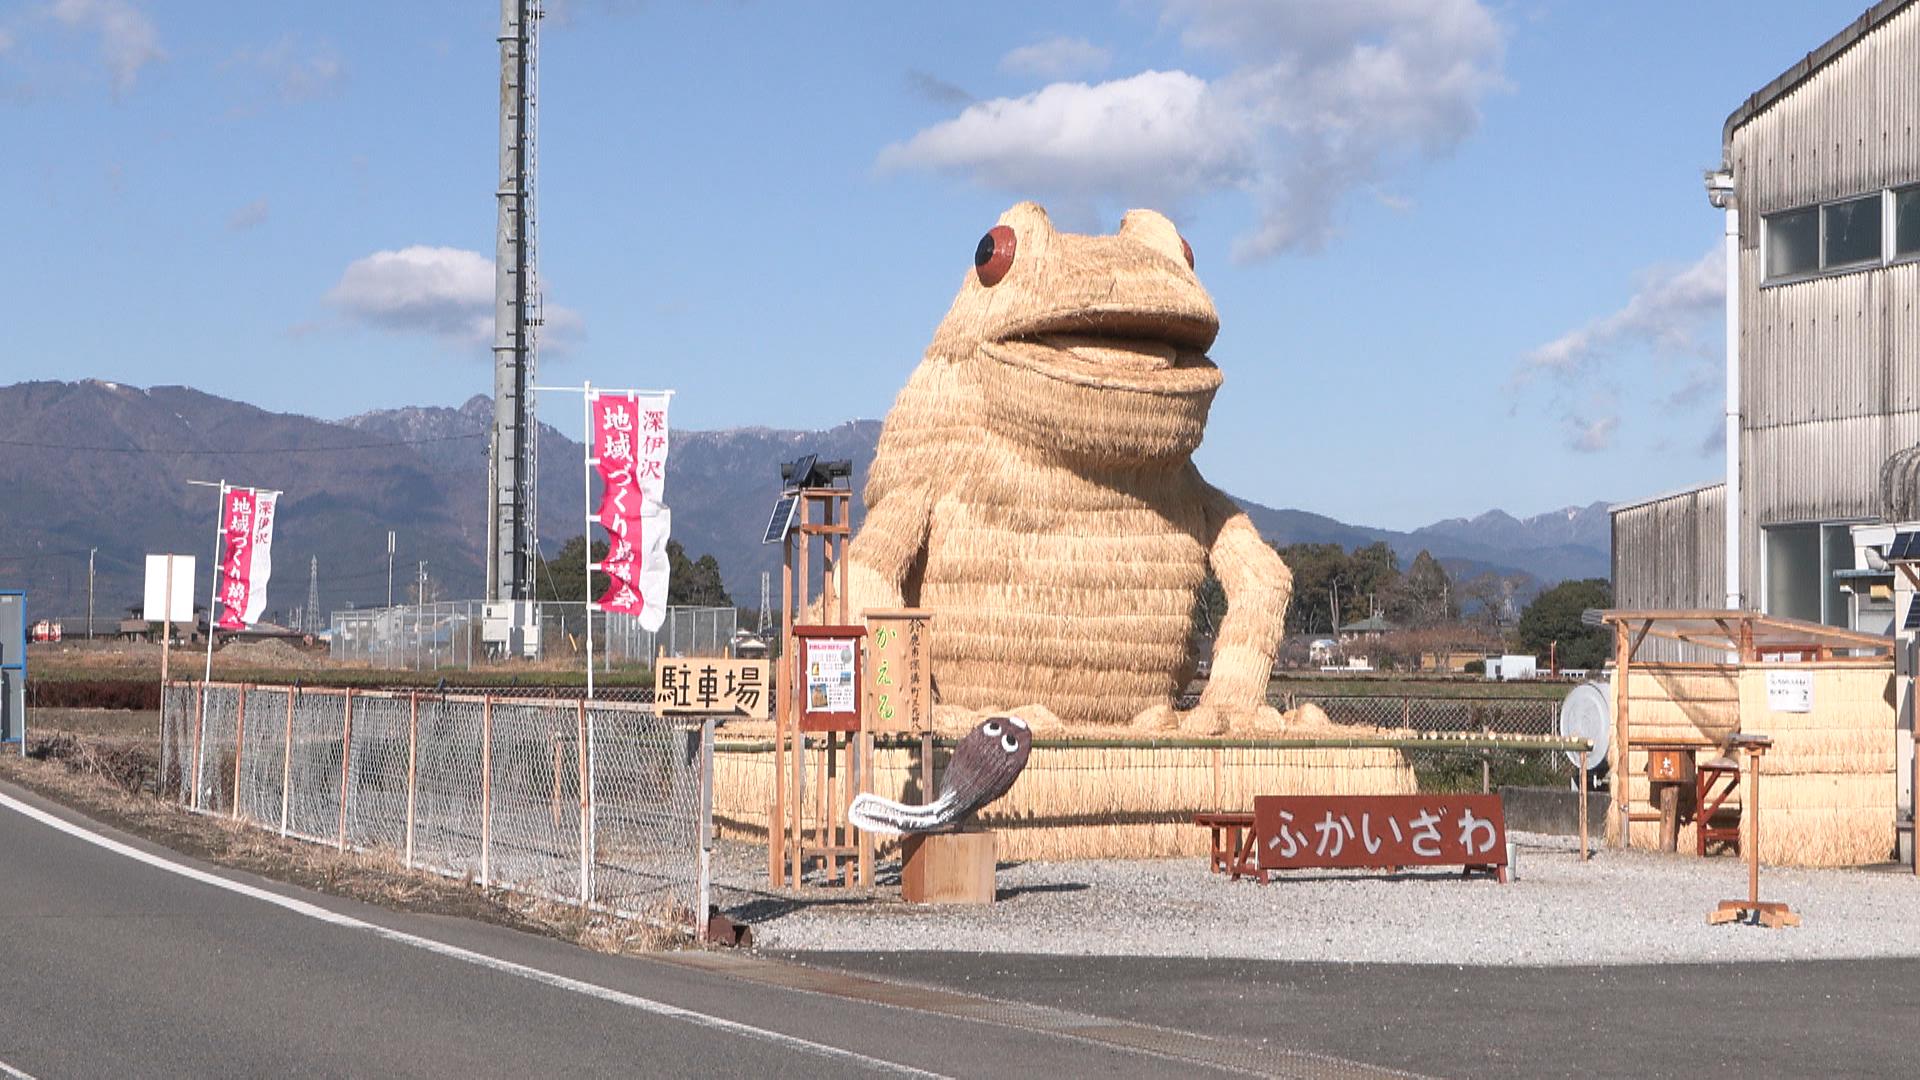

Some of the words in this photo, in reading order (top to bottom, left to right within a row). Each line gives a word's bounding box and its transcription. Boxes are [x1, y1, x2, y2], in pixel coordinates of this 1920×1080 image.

[641, 409, 667, 481] 深伊沢
[255, 501, 273, 544] 深伊沢
[657, 664, 763, 710] 駐車場
[876, 625, 897, 720] かえる
[1268, 807, 1497, 858] ふかいざわ
